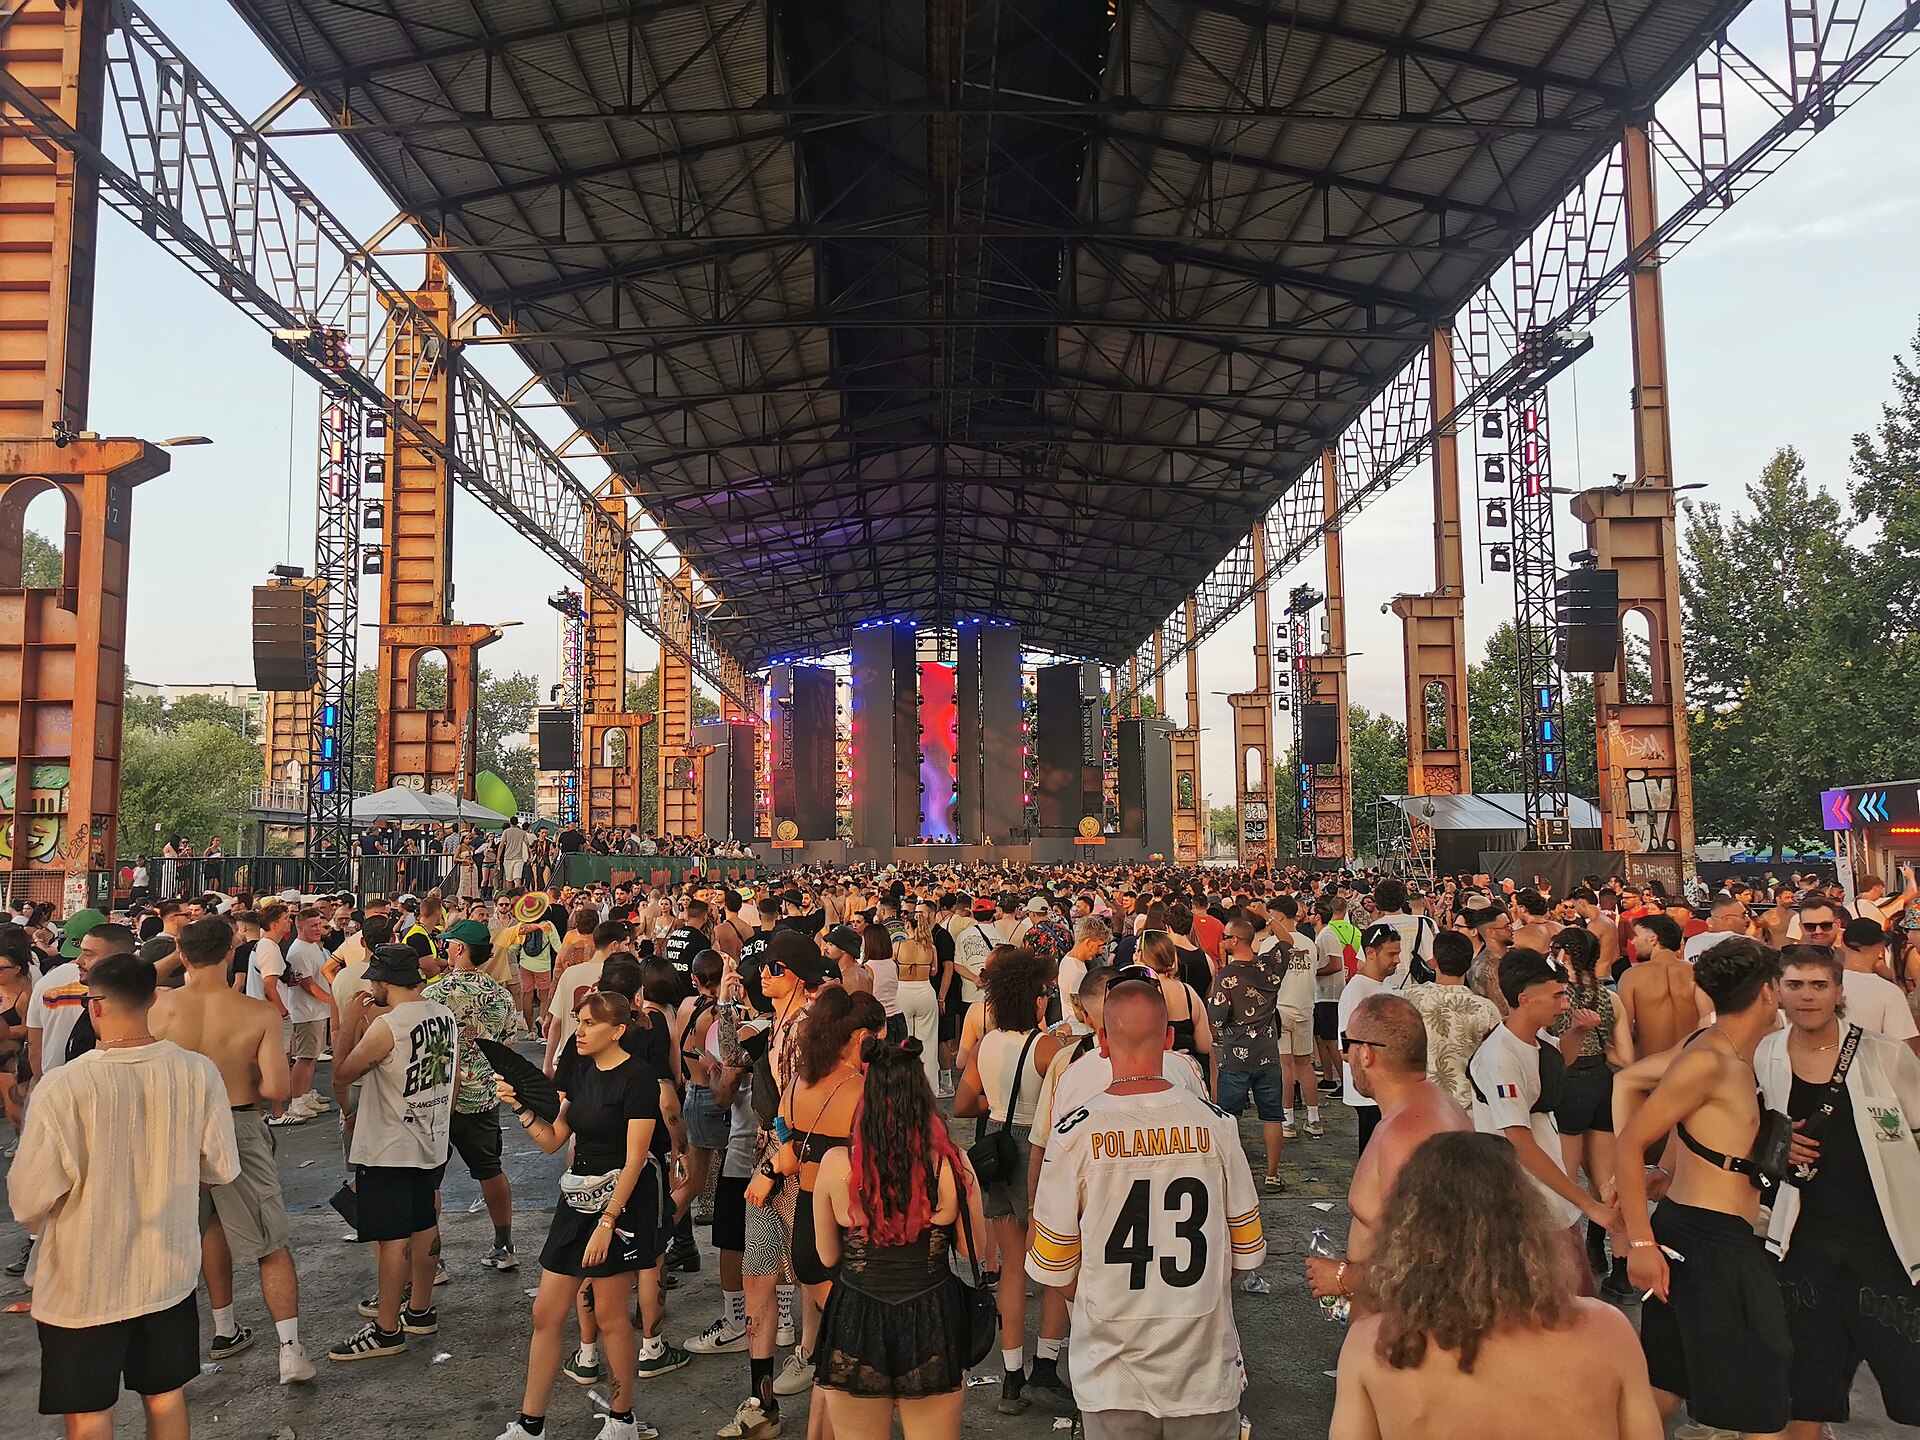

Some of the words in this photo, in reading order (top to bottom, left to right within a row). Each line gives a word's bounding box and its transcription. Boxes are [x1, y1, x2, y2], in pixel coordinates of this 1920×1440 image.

[1288, 962, 1311, 971] DIDAS
[1838, 1037, 1858, 1072] adidas
[1091, 1126, 1210, 1160] POLAMALU
[1104, 1176, 1209, 1290] 43
